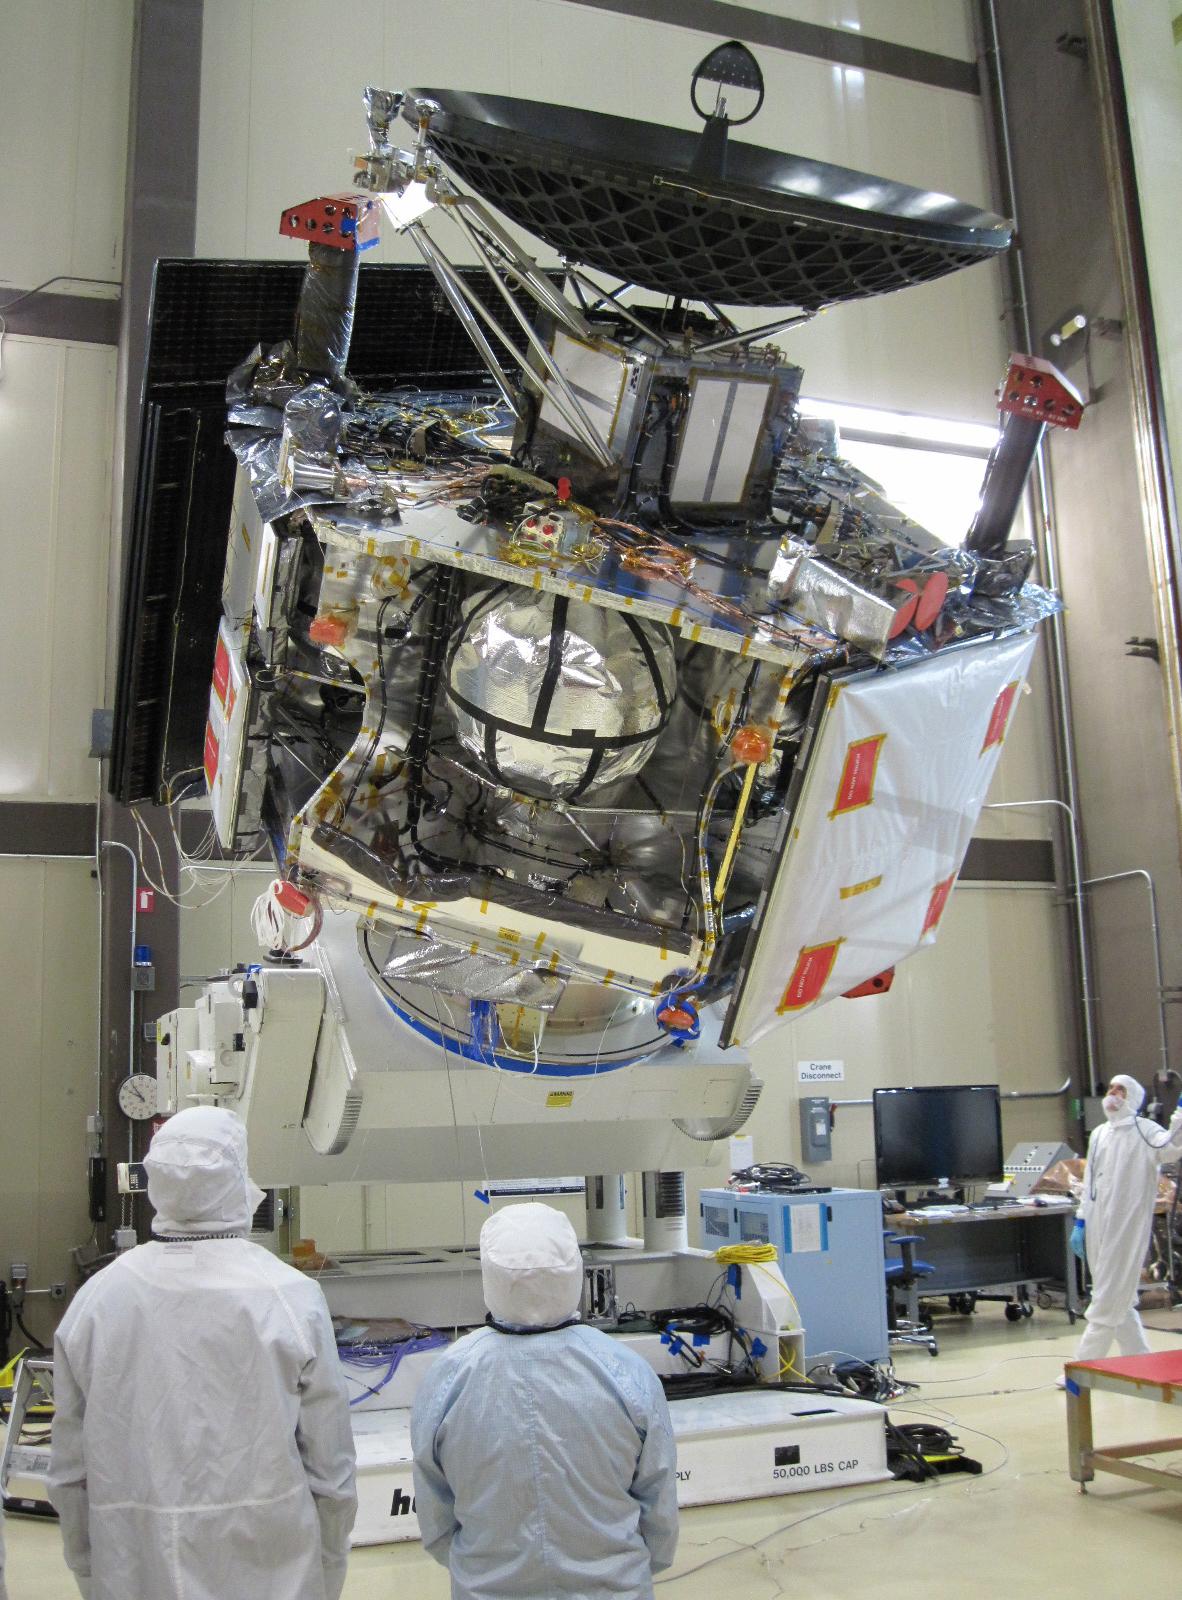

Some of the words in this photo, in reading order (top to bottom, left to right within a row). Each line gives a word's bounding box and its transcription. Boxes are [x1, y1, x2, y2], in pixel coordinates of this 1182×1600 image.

[810, 1063, 832, 1071] Crane
[801, 1072, 841, 1081] Disconnect
[773, 1465, 810, 1480] 50,000
[815, 1462, 834, 1474] LBS
[838, 1459, 859, 1471] CAP
